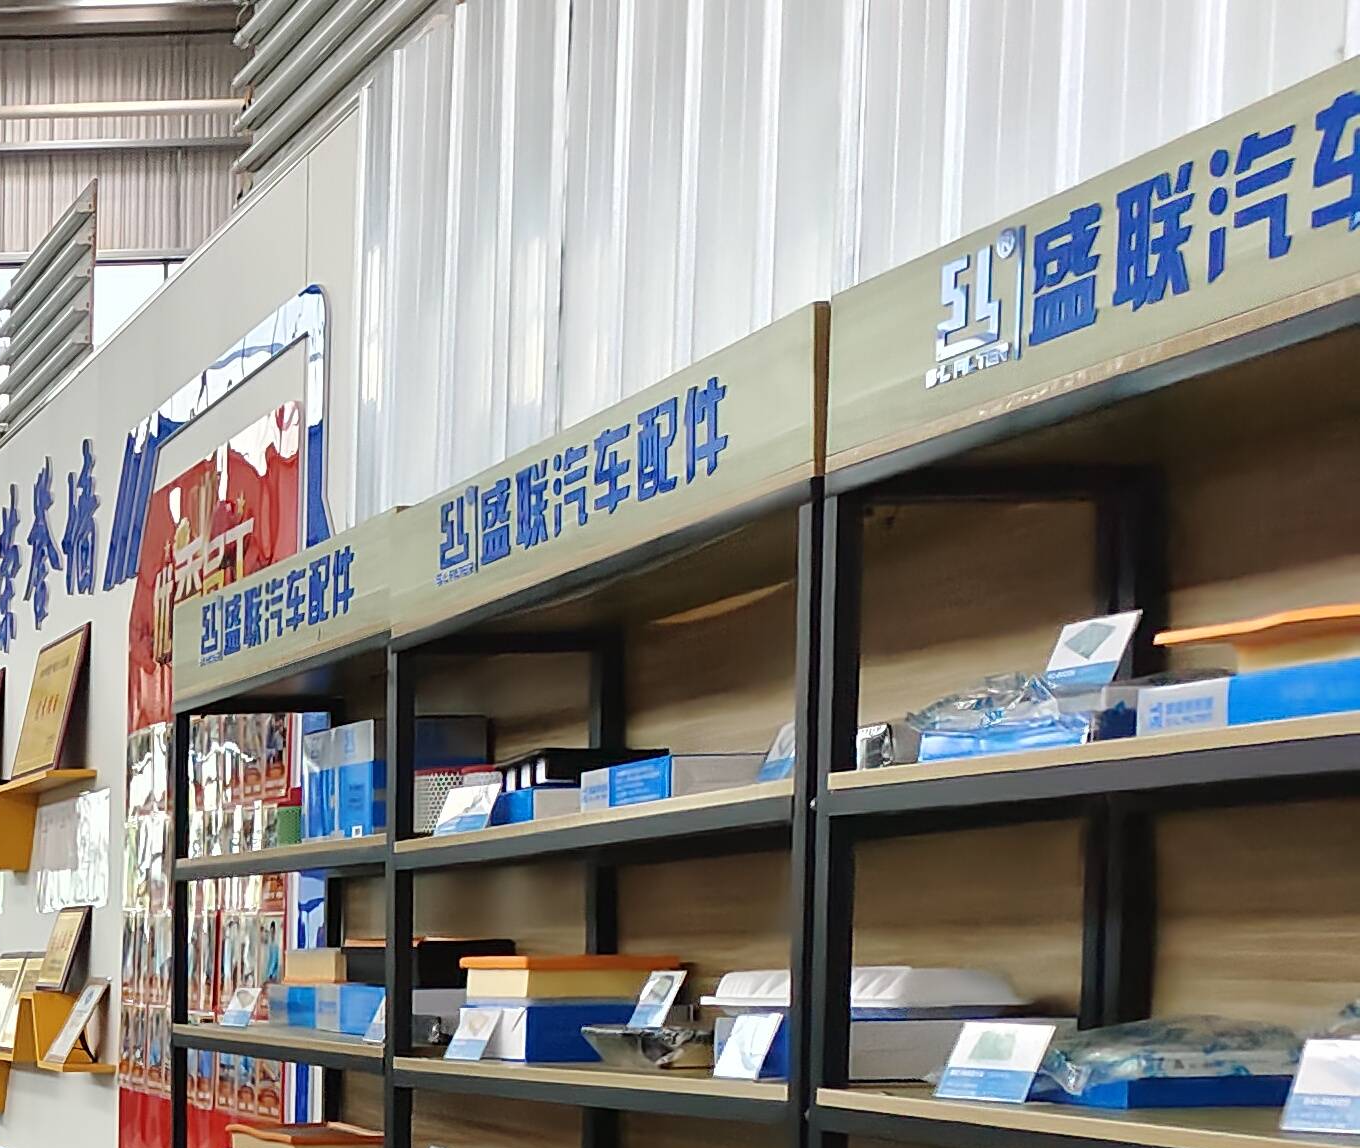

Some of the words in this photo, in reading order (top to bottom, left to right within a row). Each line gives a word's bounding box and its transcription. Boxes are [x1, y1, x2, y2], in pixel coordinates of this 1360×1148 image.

[480, 376, 728, 566] 盛联汽车配件
[223, 544, 355, 657] 盛联汽车配件
